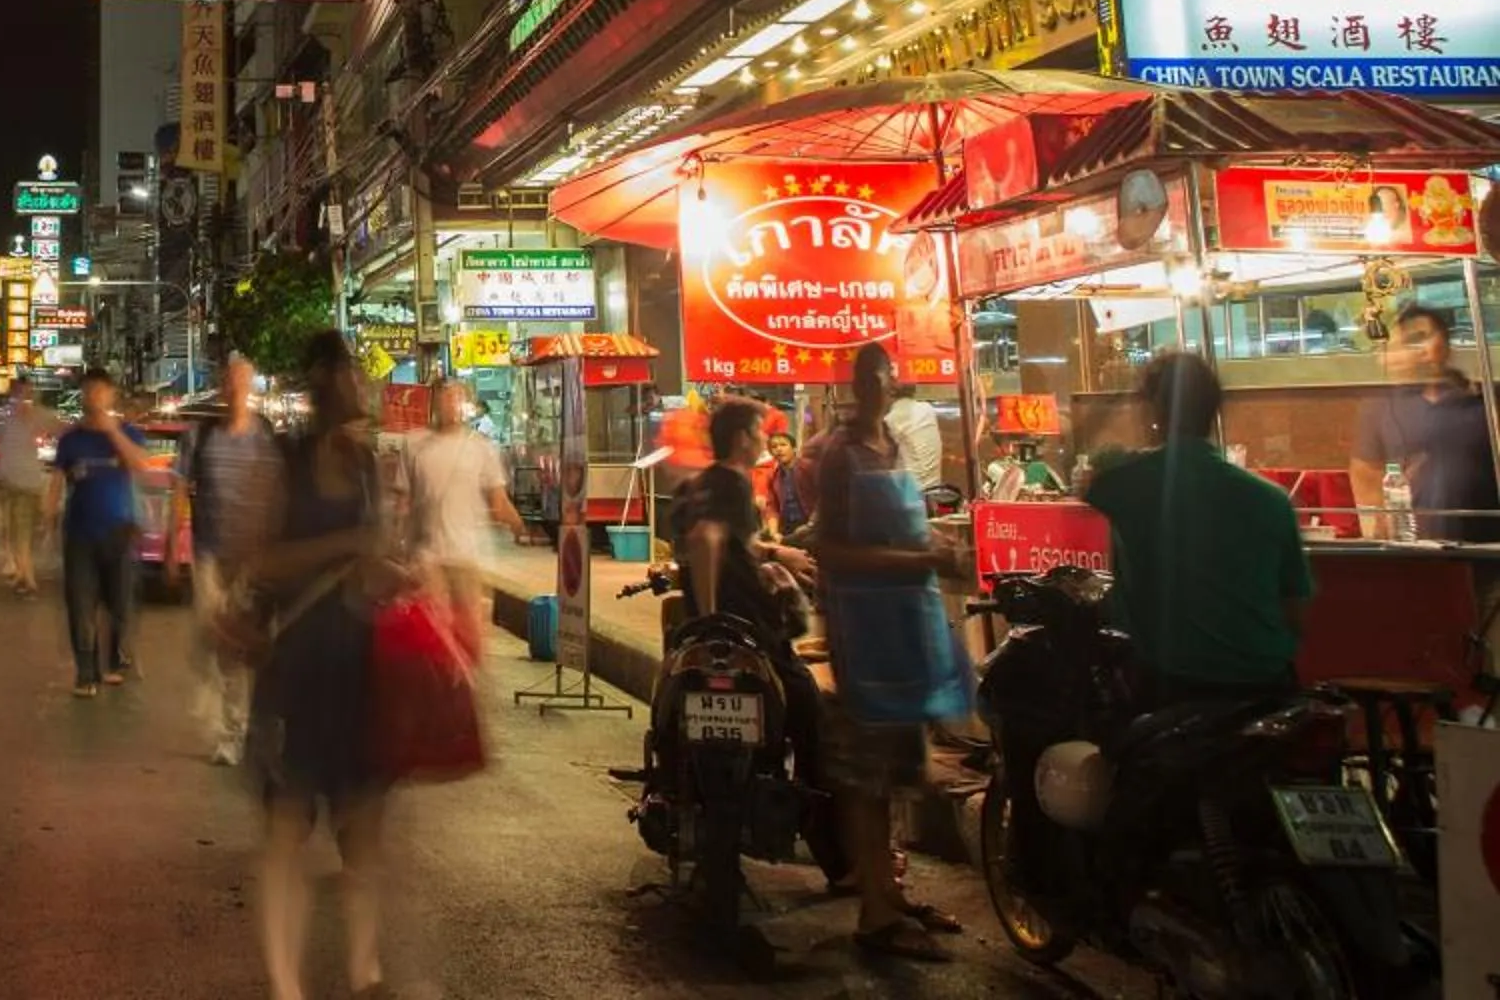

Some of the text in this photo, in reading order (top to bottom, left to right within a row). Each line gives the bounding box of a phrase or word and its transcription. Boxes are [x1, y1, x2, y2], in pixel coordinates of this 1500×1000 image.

[1201, 14, 1449, 54] 魚翅酒樓
[1141, 65, 1500, 88] CHINA TOWN SCALA RESTAURAN
[767, 304, 887, 337] เกาลัดญี่ปุ่น
[703, 359, 734, 377] 1kg
[740, 359, 771, 374] 240
[906, 359, 937, 375] 120
